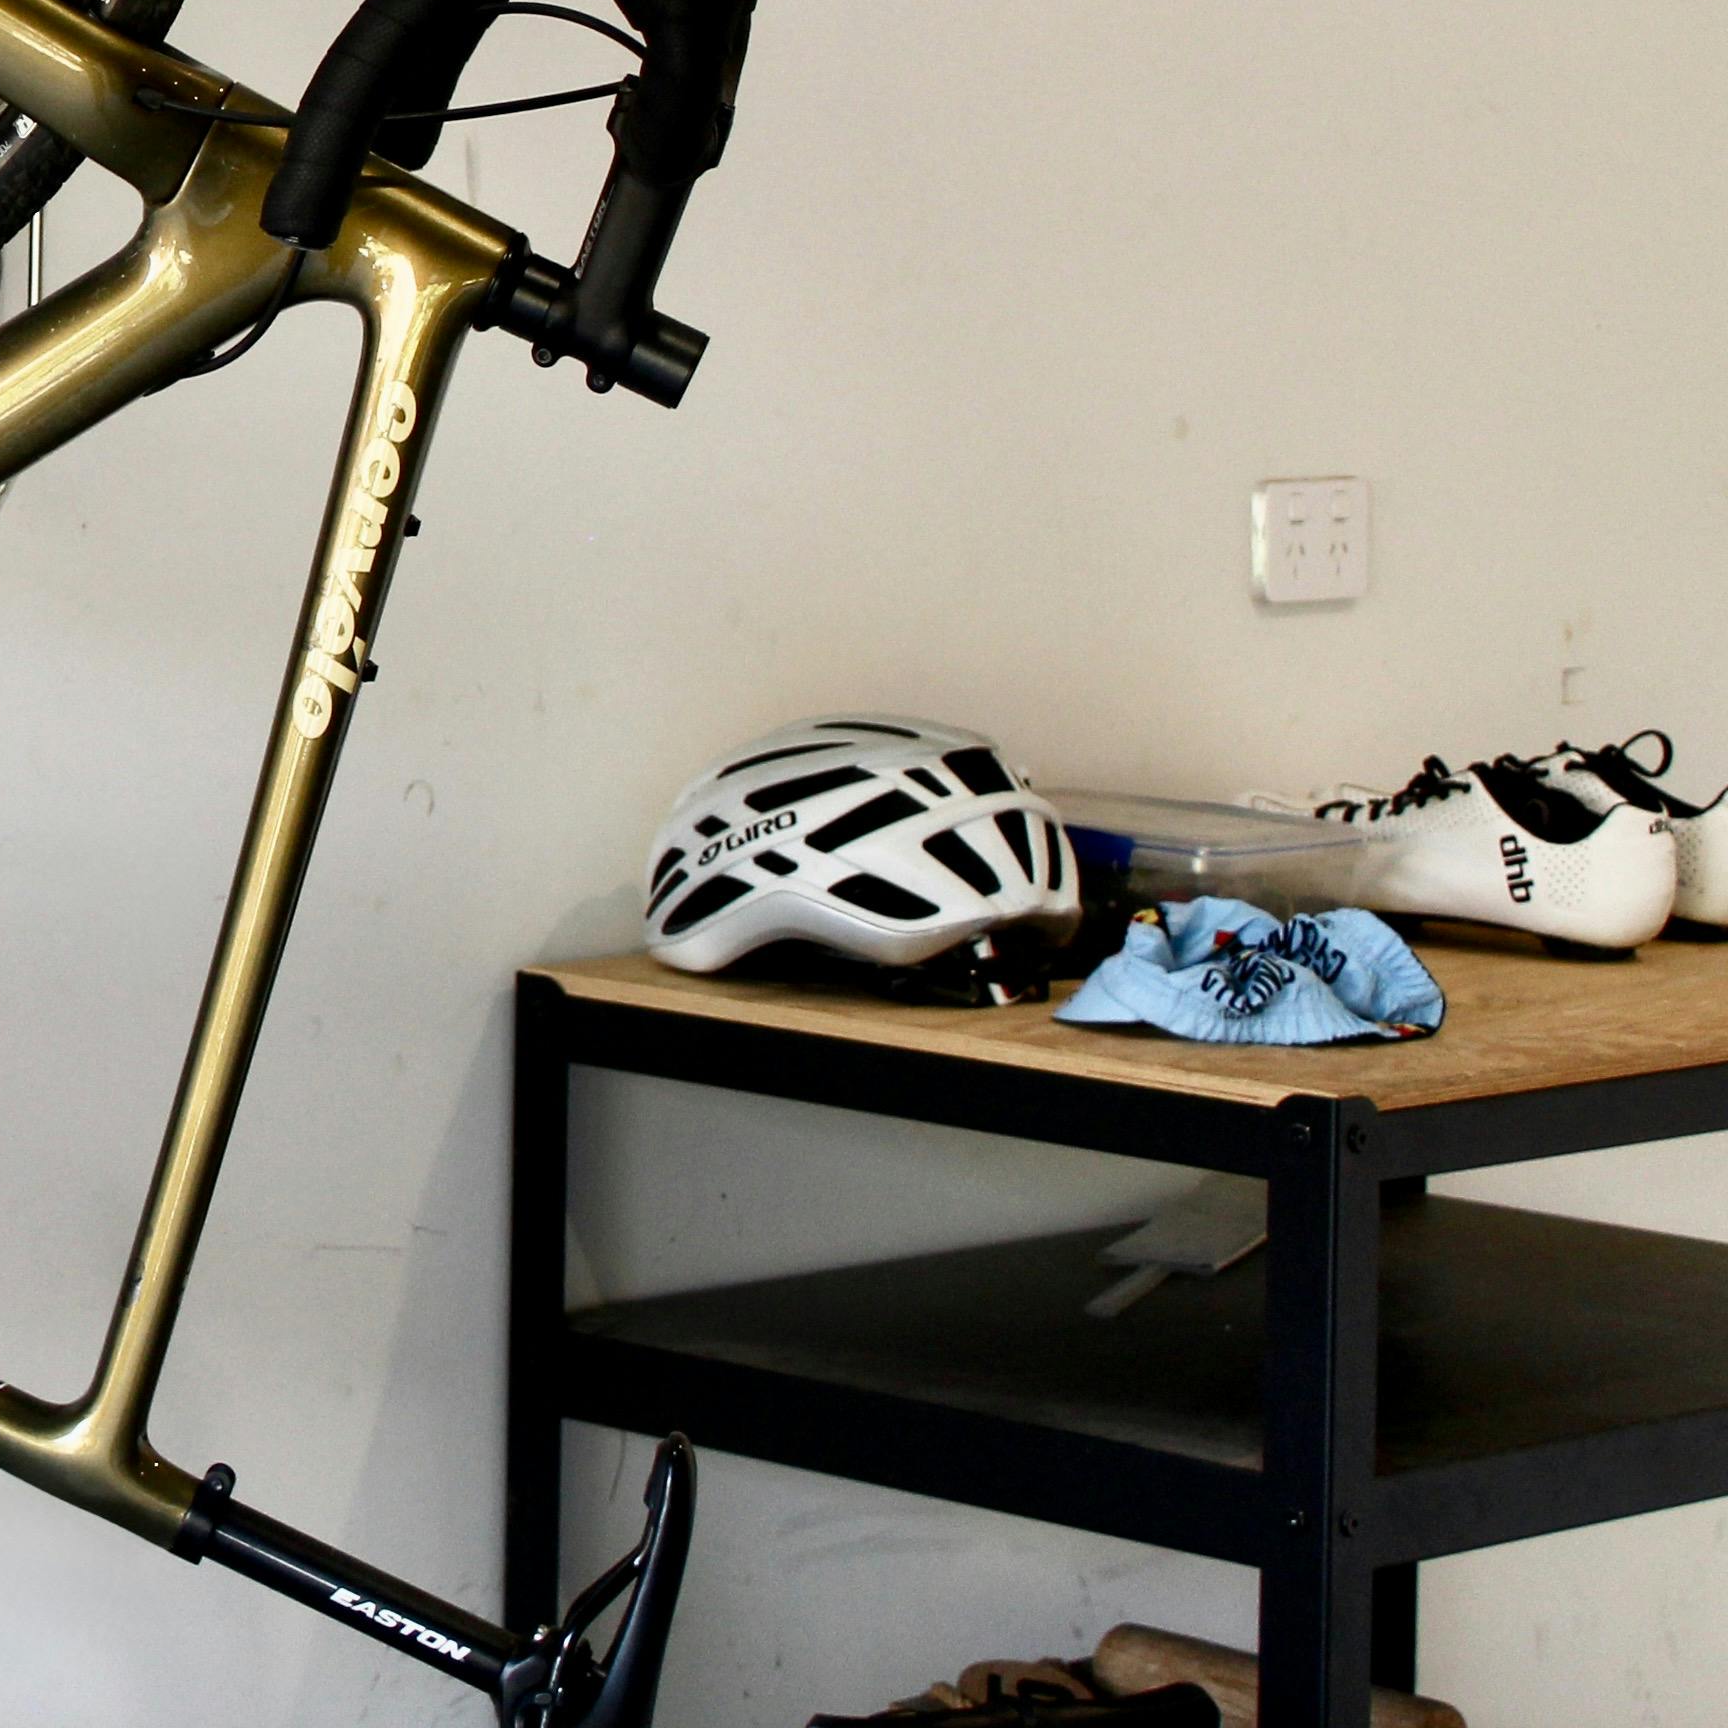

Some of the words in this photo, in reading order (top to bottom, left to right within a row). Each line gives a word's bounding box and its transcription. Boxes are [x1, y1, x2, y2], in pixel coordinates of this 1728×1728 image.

[292, 380, 418, 740] cervélo
[725, 810, 797, 851] GIRO
[1499, 834, 1532, 905] dhb
[329, 1586, 471, 1662] EASTON
